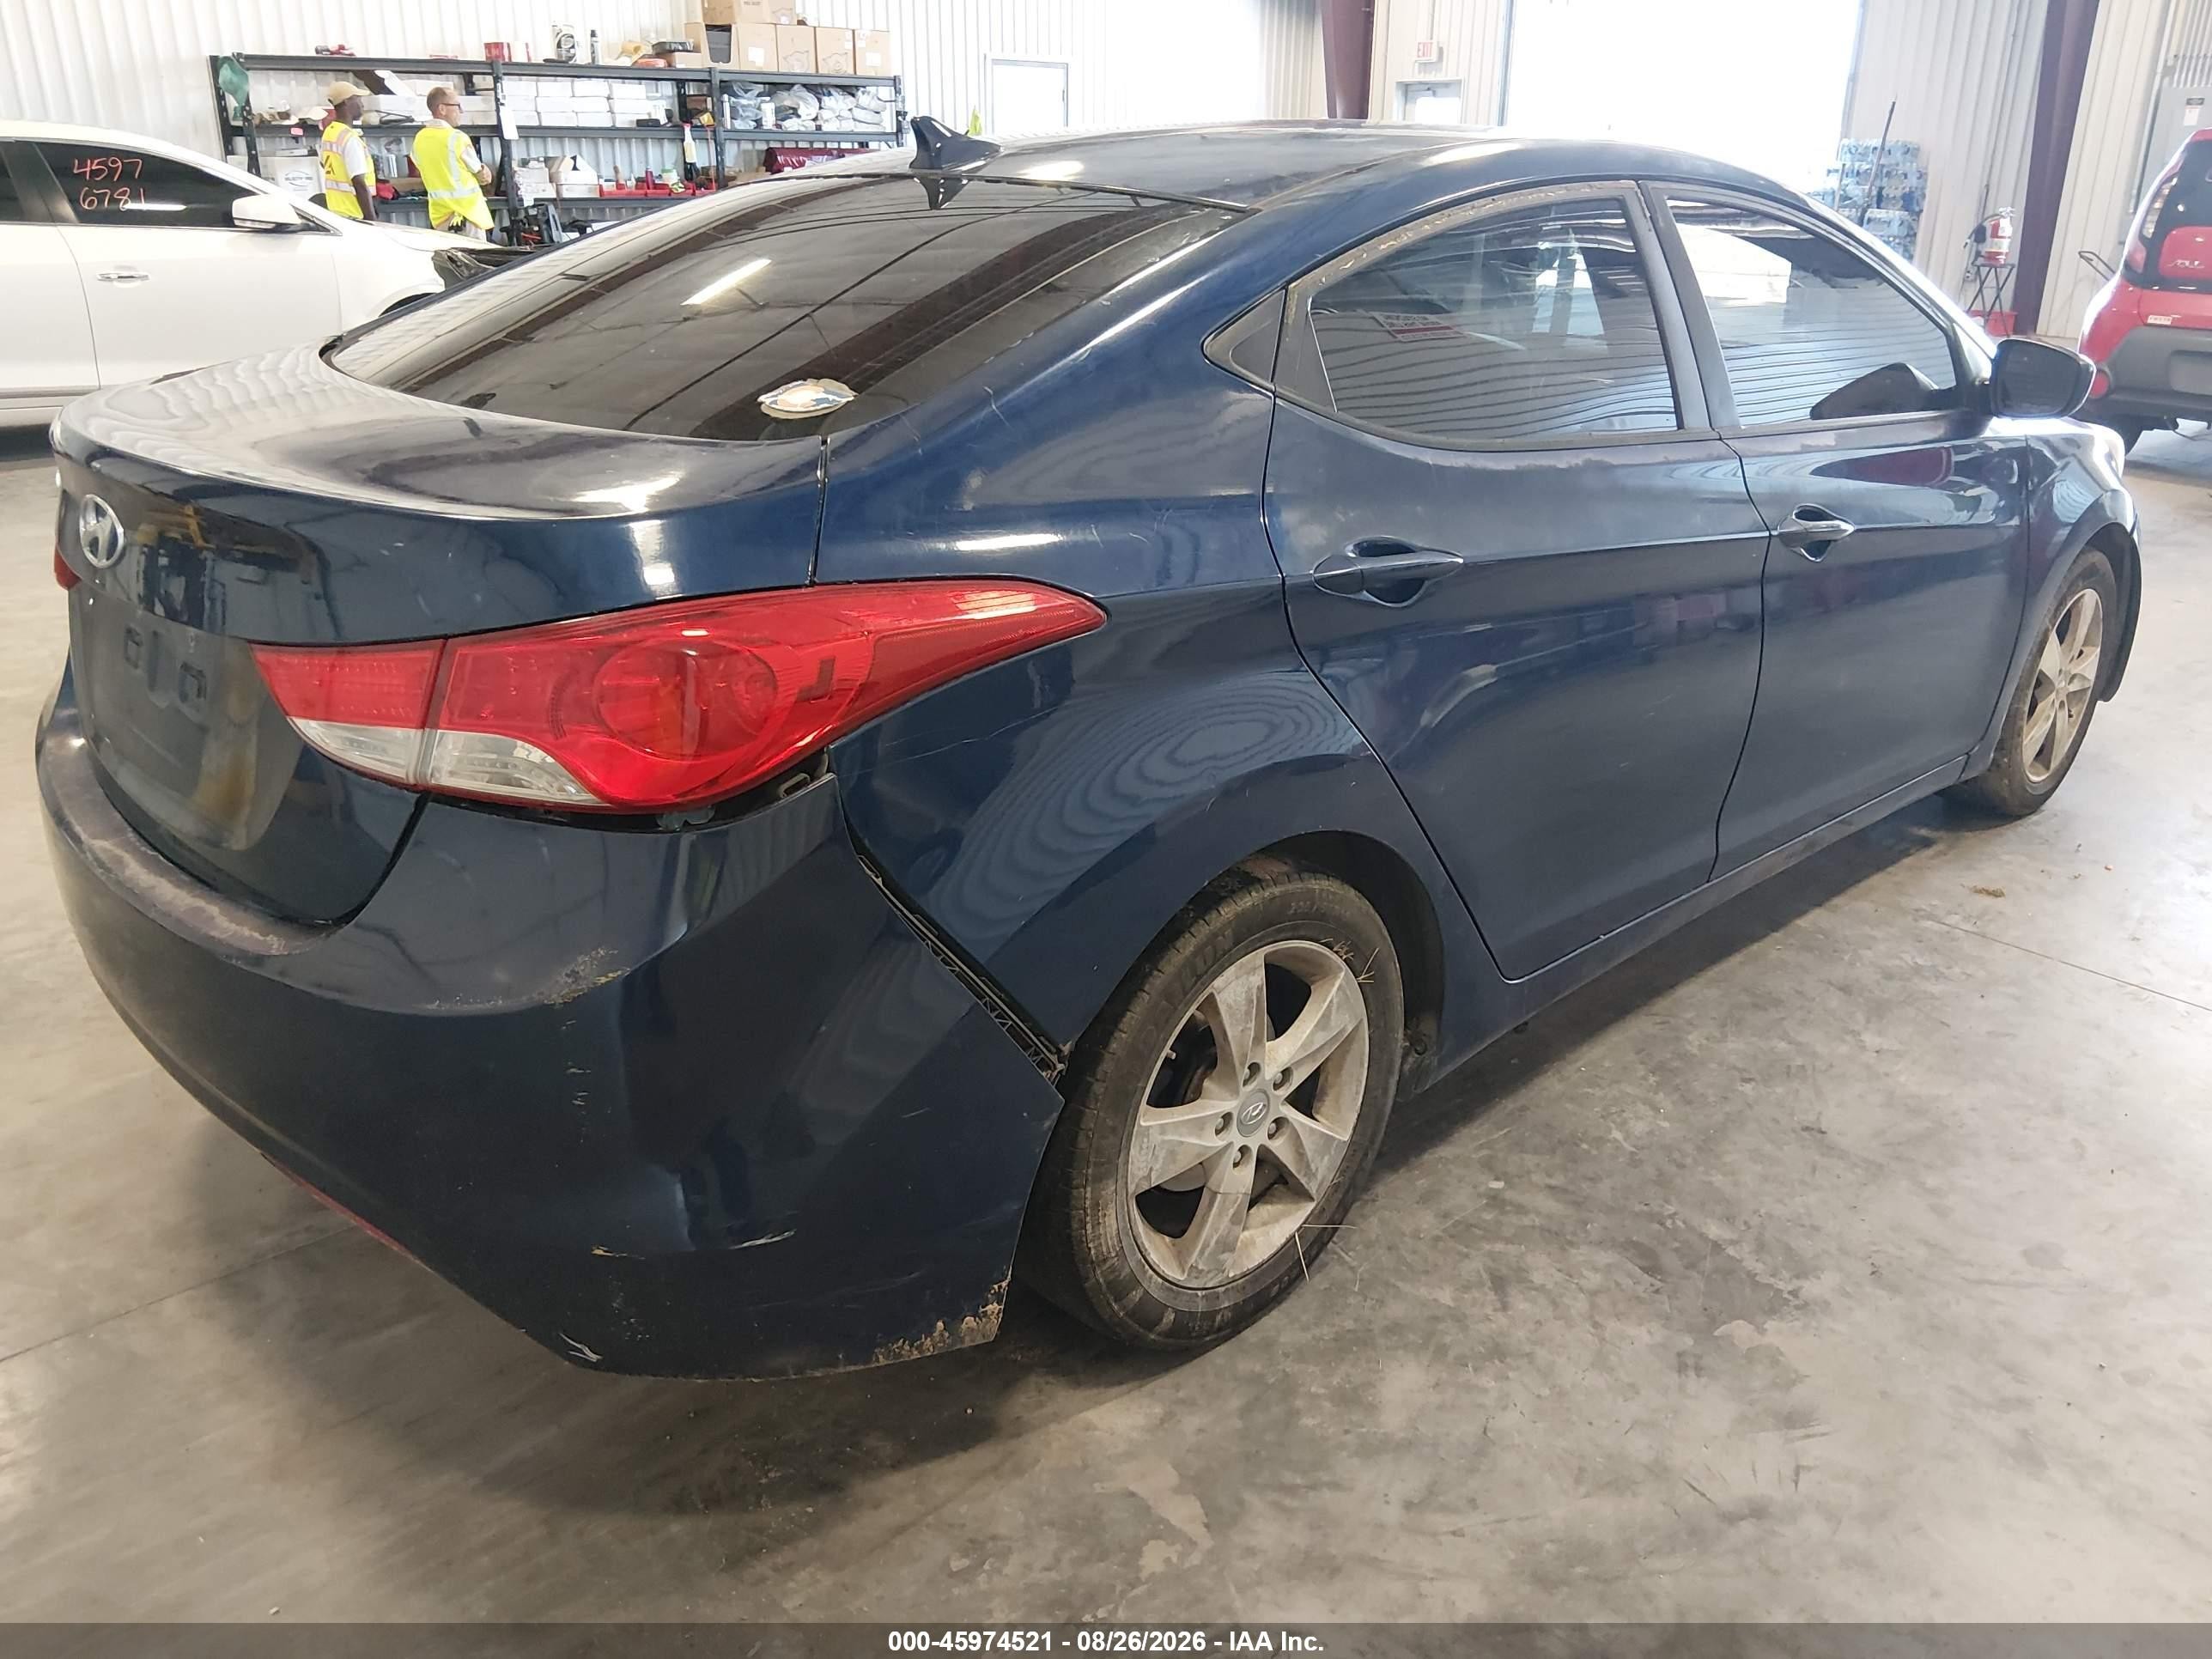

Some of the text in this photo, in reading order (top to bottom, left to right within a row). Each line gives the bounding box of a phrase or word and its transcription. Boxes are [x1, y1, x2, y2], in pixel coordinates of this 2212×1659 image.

[1417, 42, 1433, 58] EXIT
[74, 157, 143, 181] 4597
[80, 187, 144, 211] 6781
